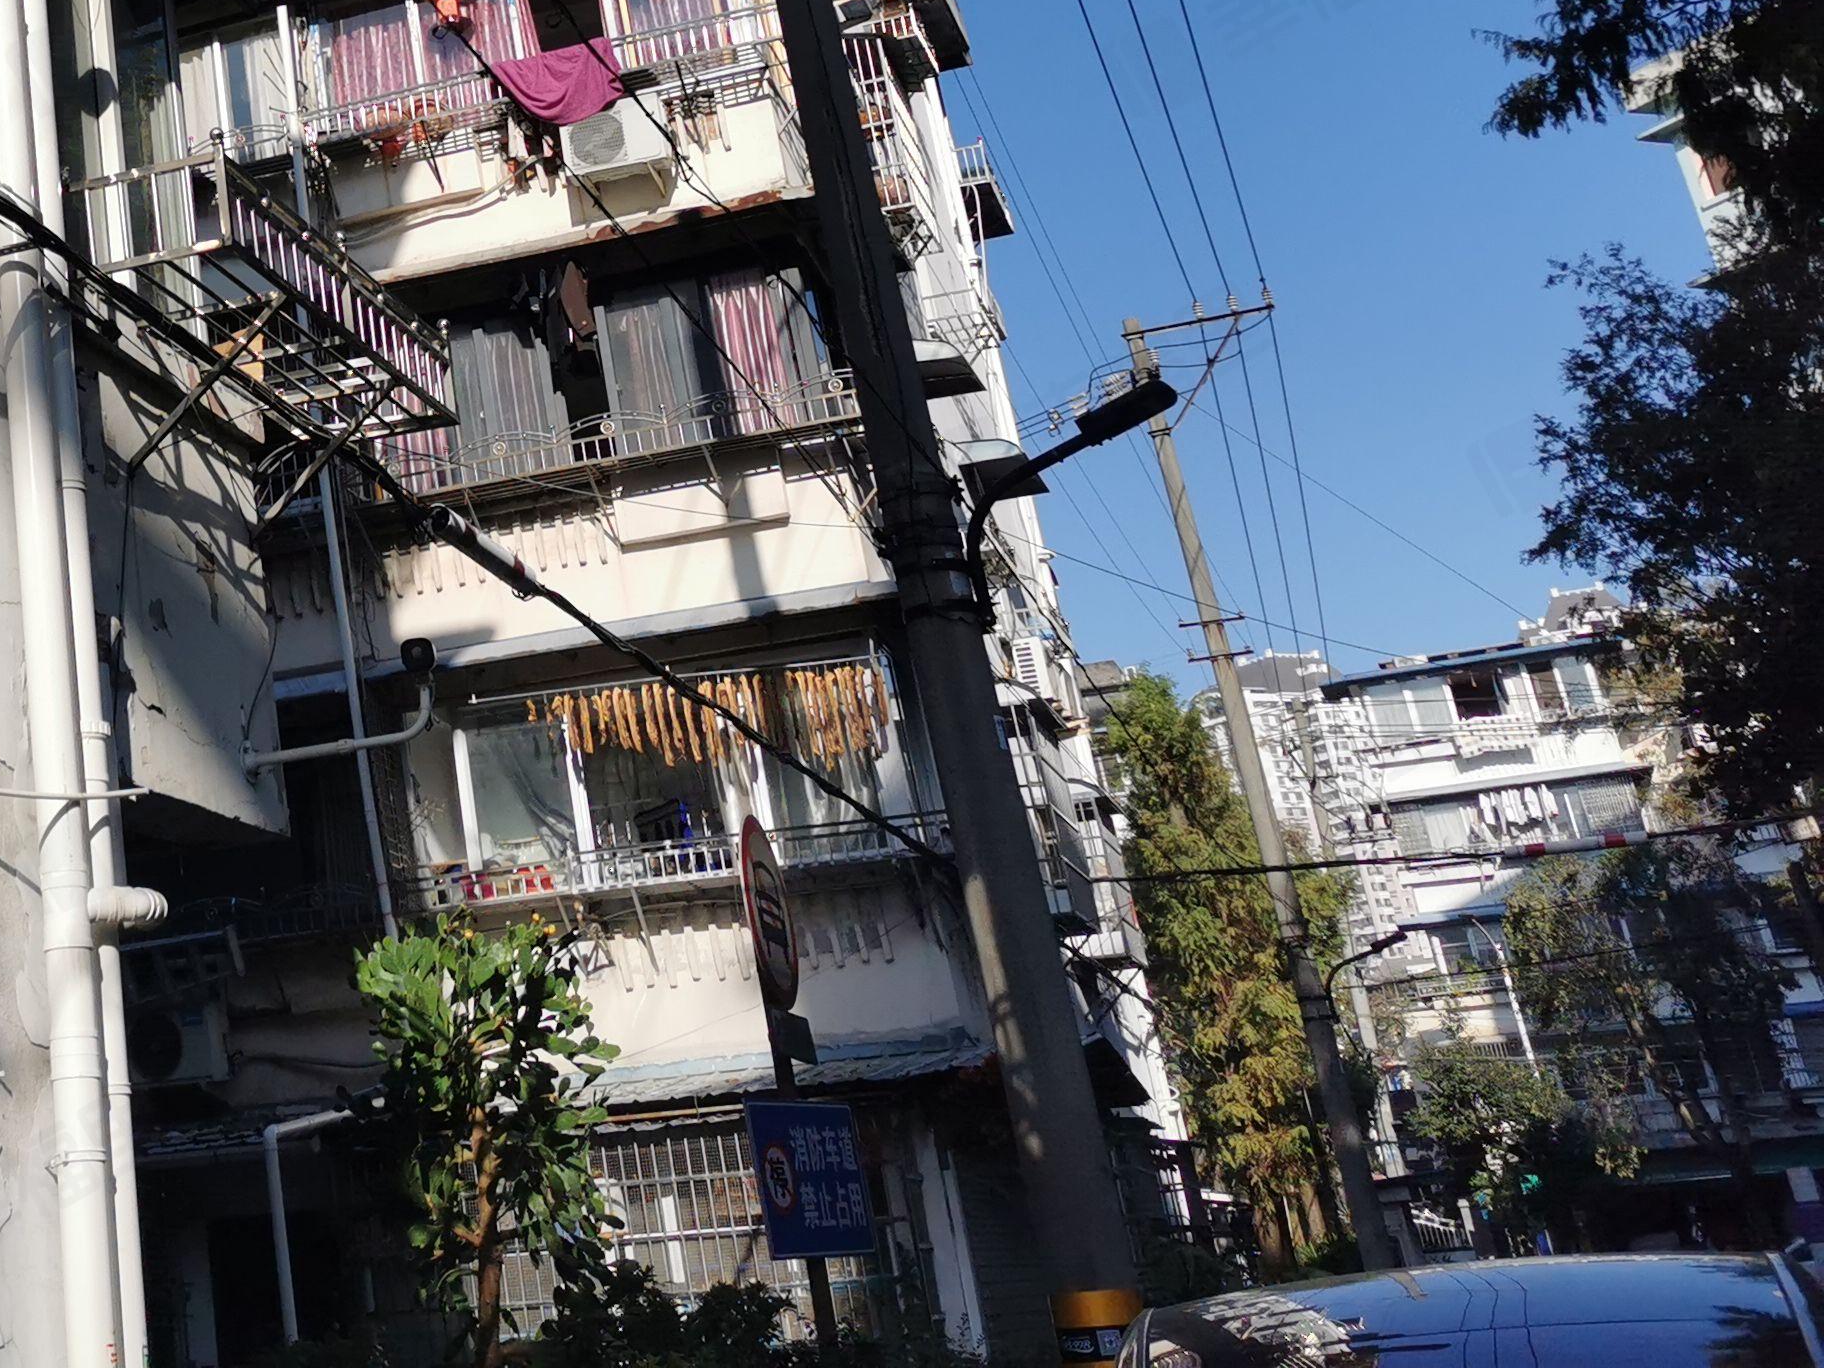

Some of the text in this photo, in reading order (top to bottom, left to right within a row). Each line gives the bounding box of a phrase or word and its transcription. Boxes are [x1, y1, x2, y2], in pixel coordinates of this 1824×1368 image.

[789, 1125, 858, 1172] 消防车道
[800, 1182, 867, 1230] 禁止占用
